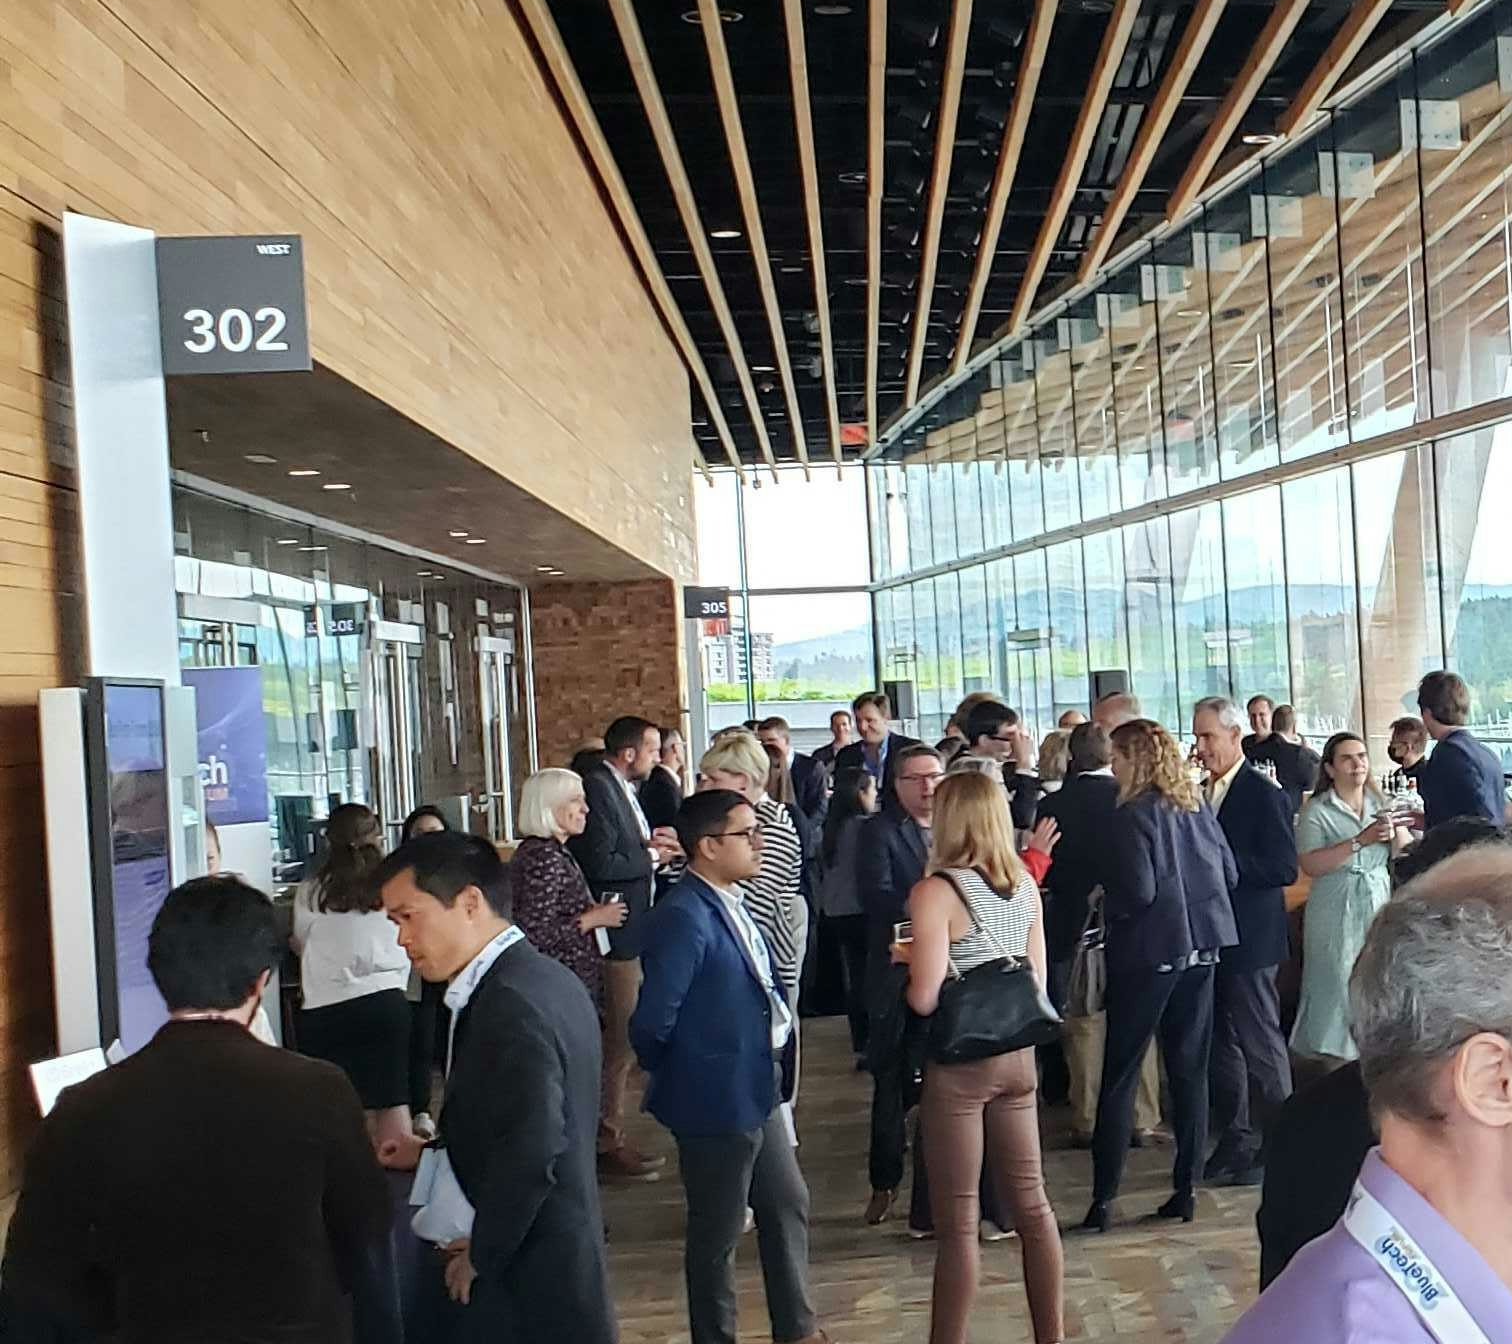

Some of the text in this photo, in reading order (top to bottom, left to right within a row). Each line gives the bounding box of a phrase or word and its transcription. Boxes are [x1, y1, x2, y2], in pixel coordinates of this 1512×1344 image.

[255, 244, 291, 255] WEST
[183, 307, 289, 353] 302
[701, 601, 728, 614] 305
[1381, 1237, 1439, 1302] BlueTech
